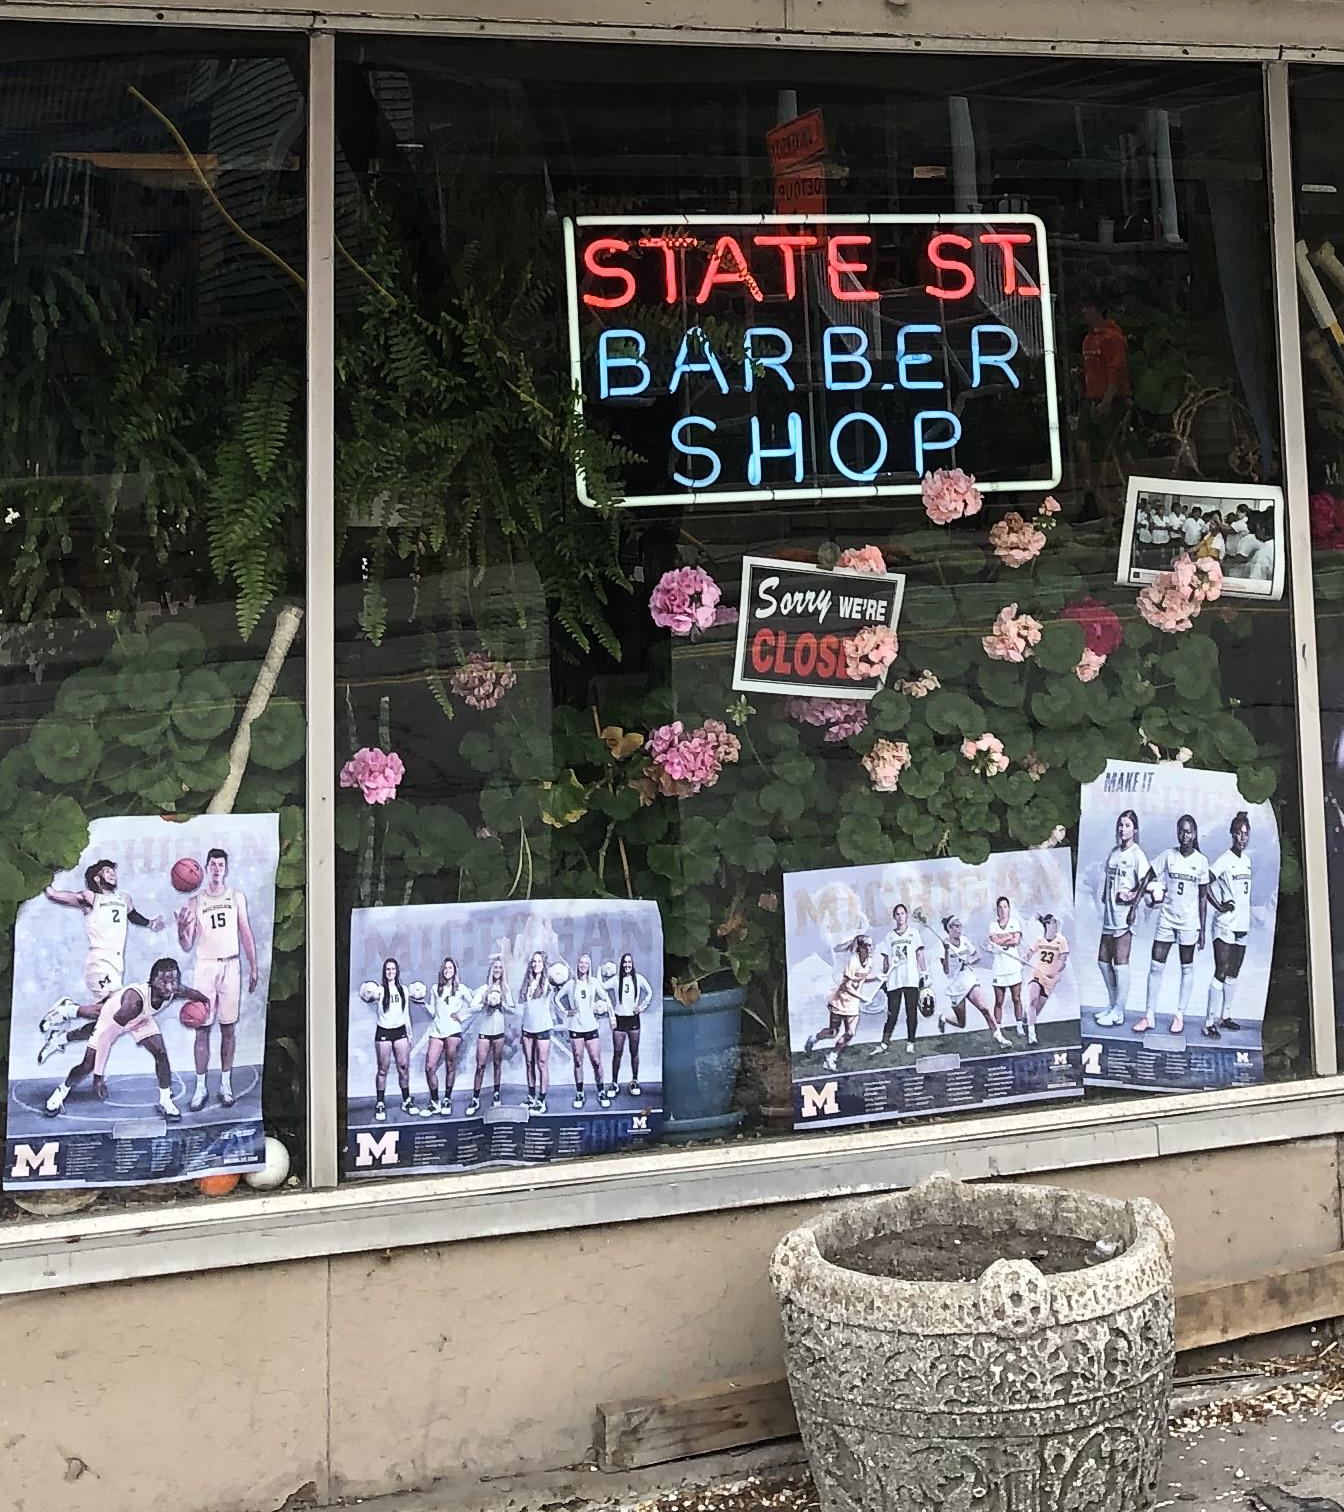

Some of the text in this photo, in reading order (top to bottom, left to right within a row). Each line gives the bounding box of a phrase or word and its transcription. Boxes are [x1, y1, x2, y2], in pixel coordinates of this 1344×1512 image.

[583, 232, 880, 307] STATE
[598, 324, 1020, 399] BARBER
[670, 410, 962, 488] SHOP
[755, 576, 888, 624] Sorry WE'RE
[752, 628, 849, 679] CLOS
[1104, 772, 1154, 792] MAKE IT
[210, 912, 226, 930] 15
[1040, 950, 1054, 965] 23
[800, 1080, 840, 1117] M
[11, 1141, 60, 1177] M
[356, 1130, 401, 1167] M
